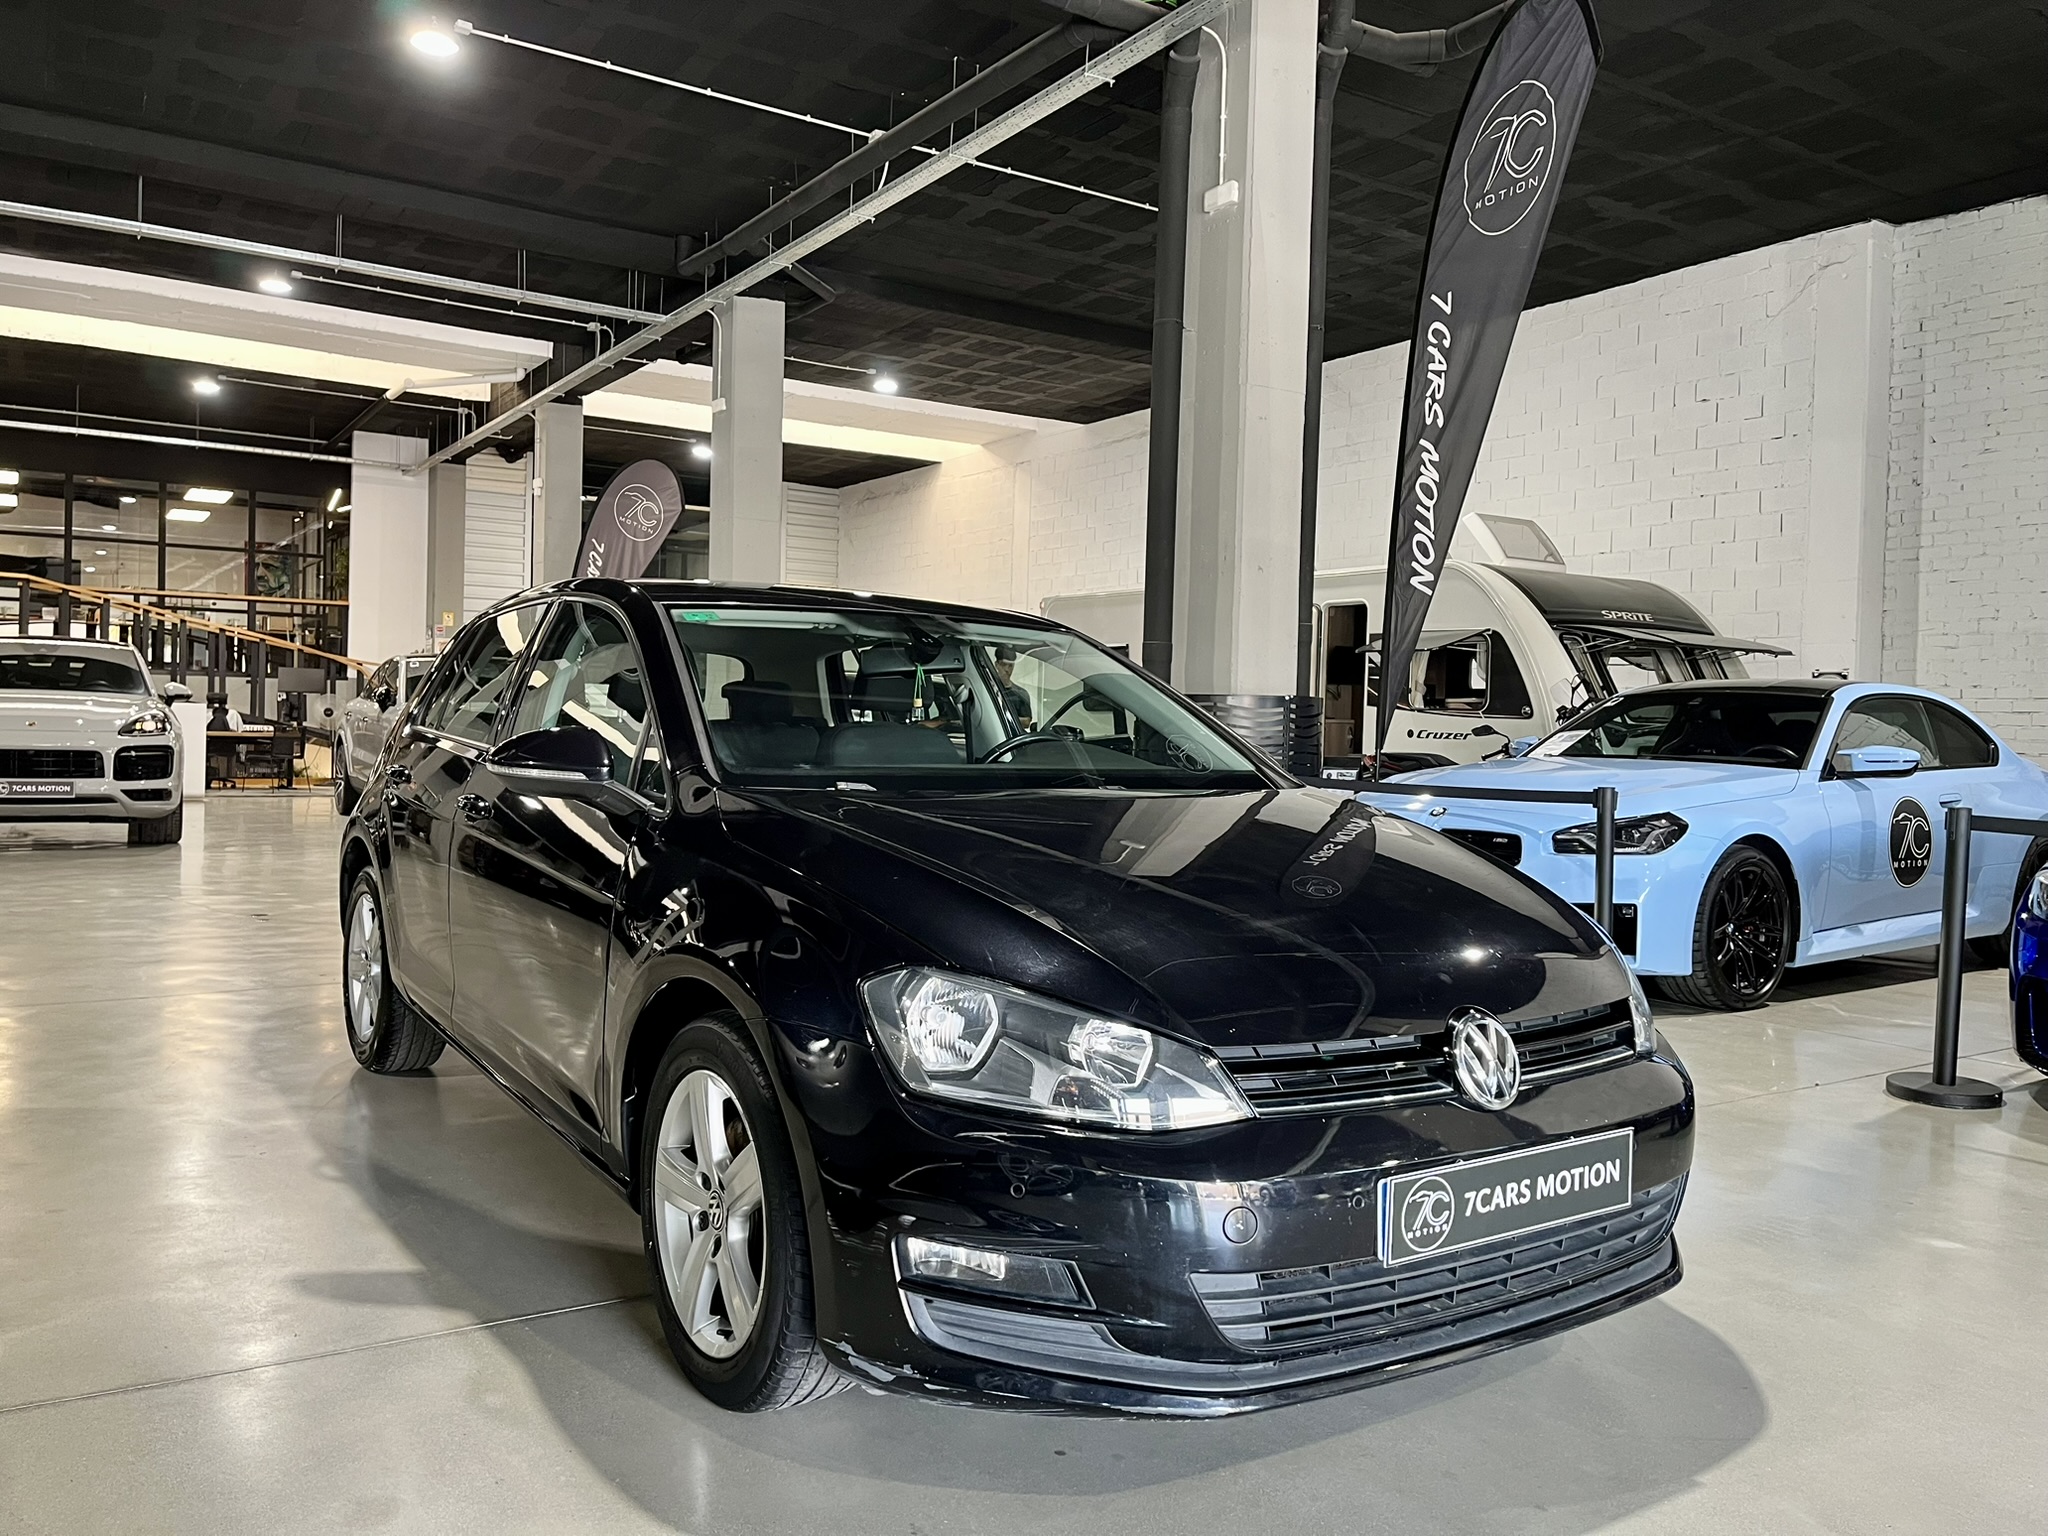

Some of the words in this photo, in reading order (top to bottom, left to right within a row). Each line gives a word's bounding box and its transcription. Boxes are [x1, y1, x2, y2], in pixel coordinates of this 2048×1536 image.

[1474, 176, 1539, 210] MOTION
[1430, 290, 1453, 316] 7
[1425, 320, 1452, 429] CARS
[619, 516, 654, 535] MOTION
[1409, 438, 1441, 597] MOTION
[591, 538, 605, 554] 7
[1416, 729, 1473, 741] Cruzer
[1893, 859, 1929, 869] MOTION
[1463, 1178, 1532, 1217] 7CARS
[1536, 1158, 1621, 1200] MOTION
[1407, 1223, 1448, 1239] MOTION
